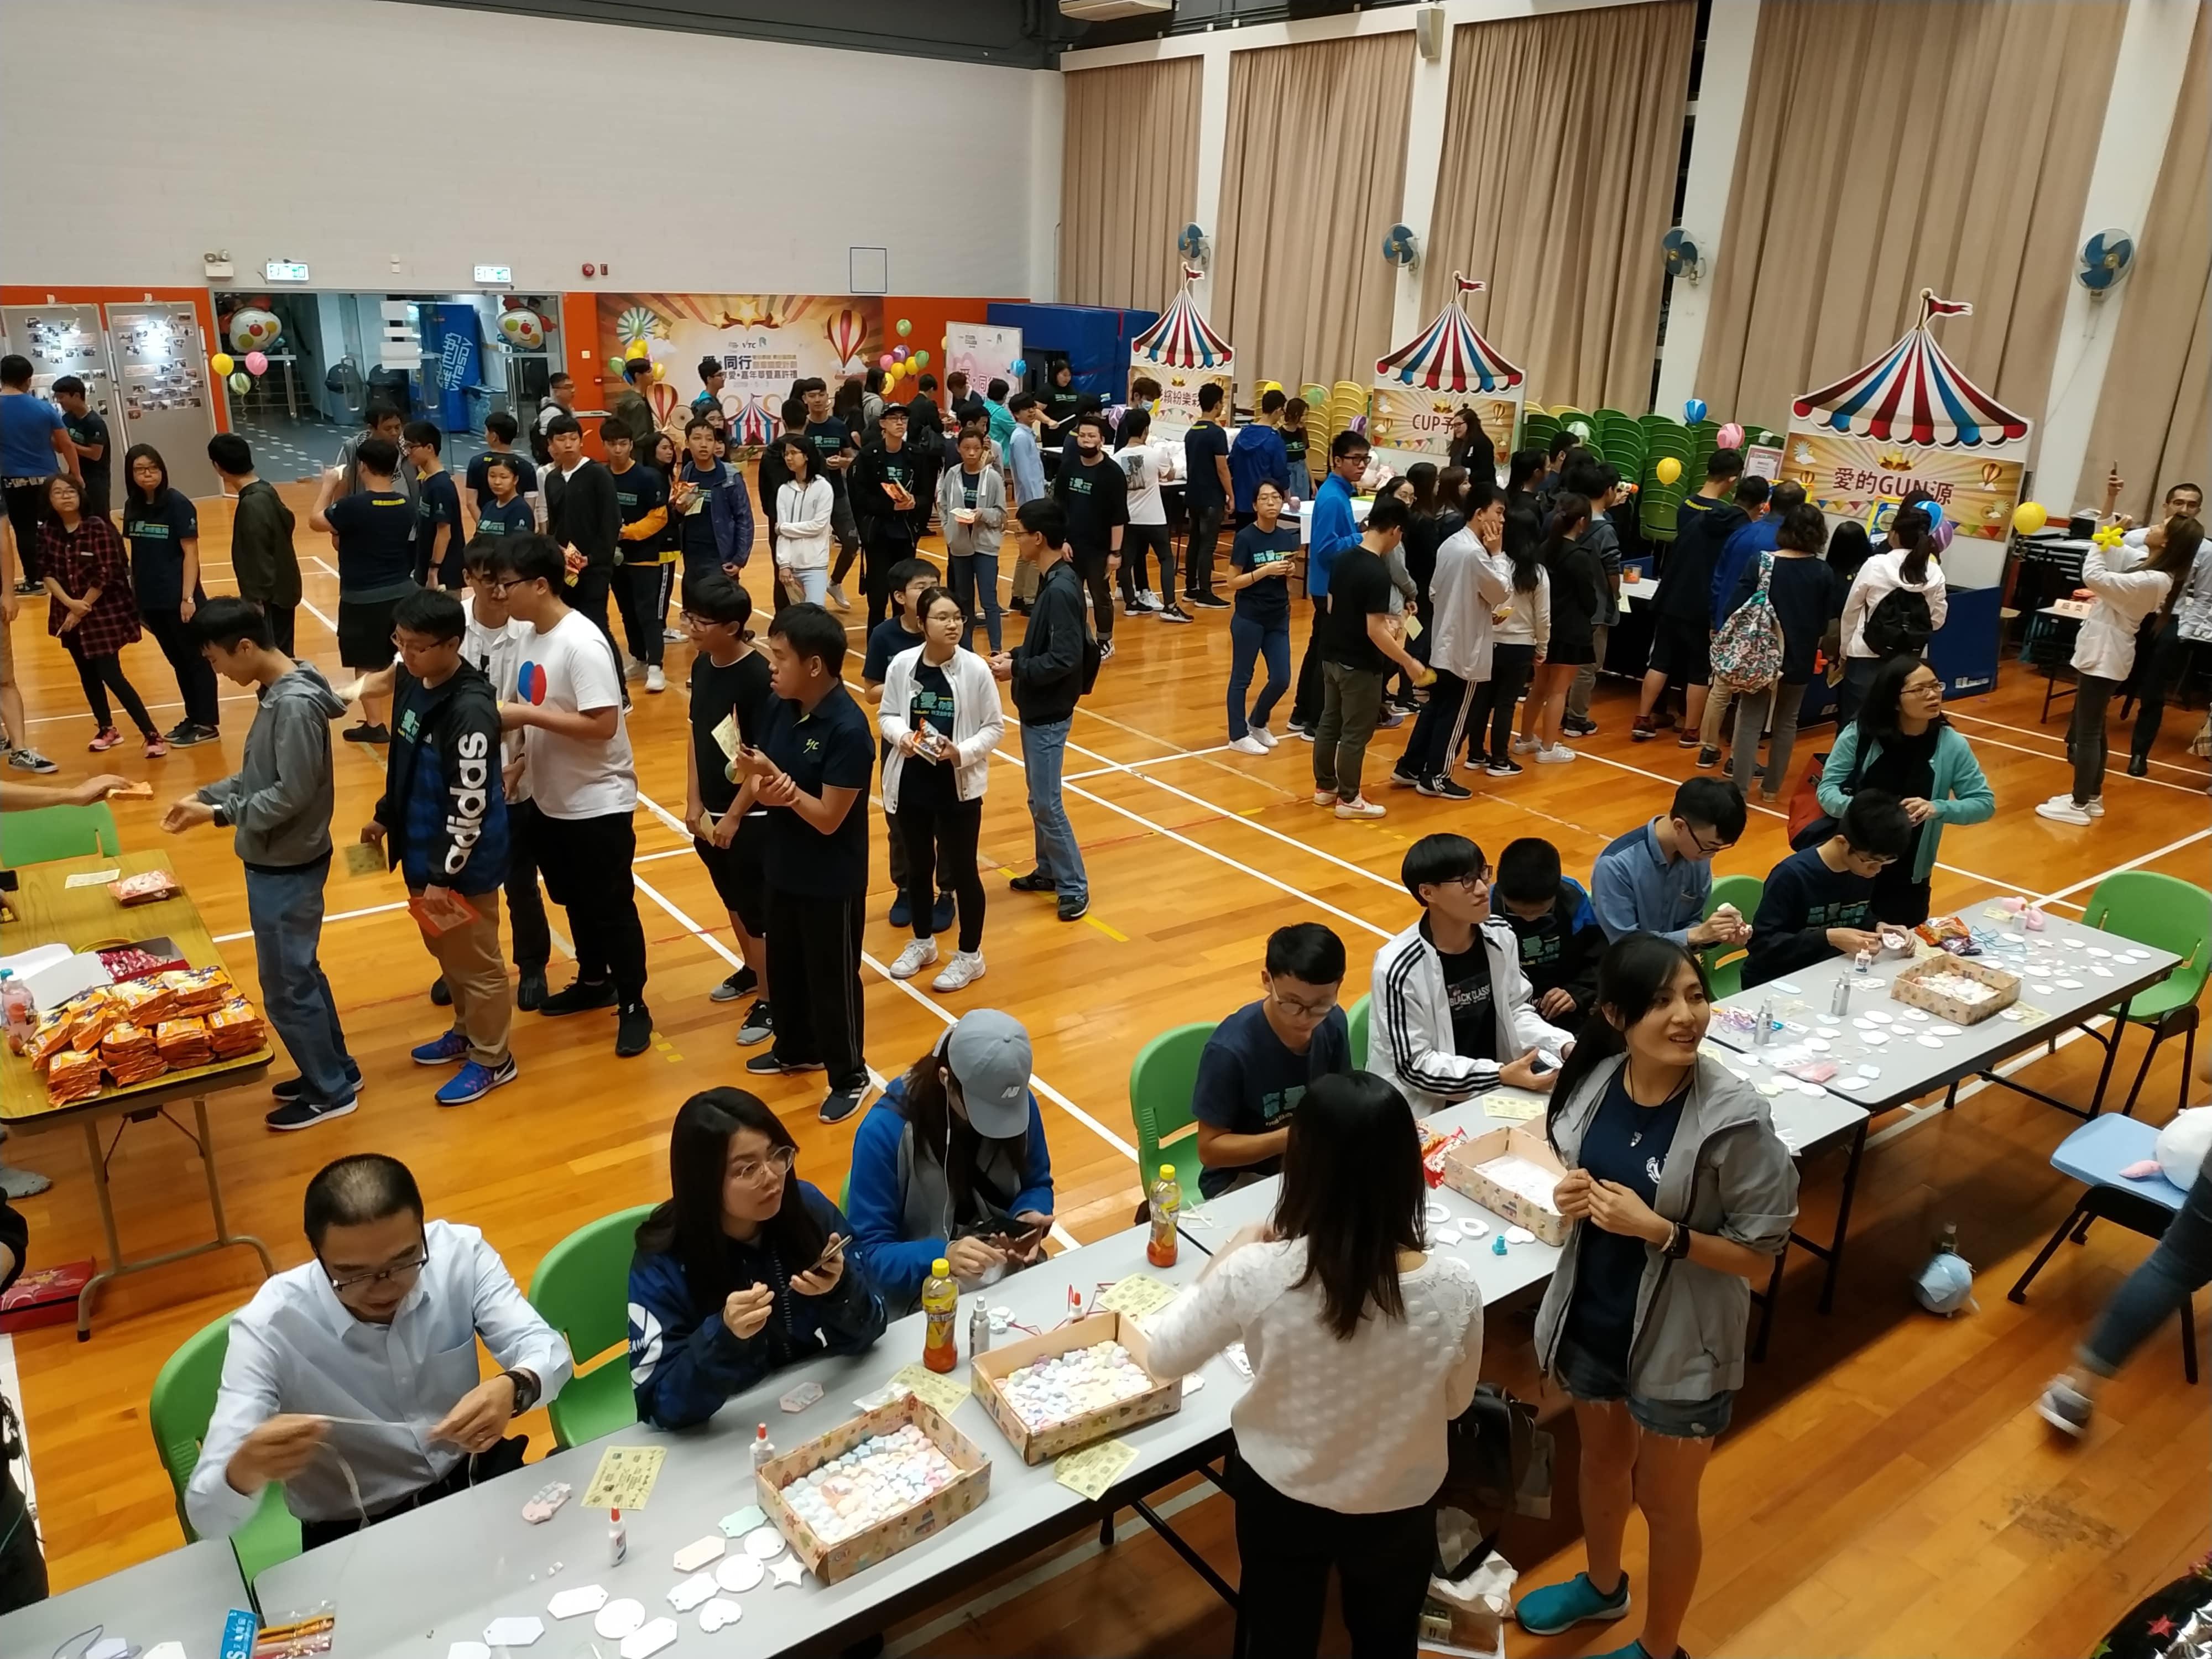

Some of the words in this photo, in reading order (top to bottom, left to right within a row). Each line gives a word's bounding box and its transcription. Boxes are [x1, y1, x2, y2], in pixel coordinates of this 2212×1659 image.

[742, 339, 757, 348] VTC
[1833, 467, 1955, 505] 愛的GUN源
[445, 732, 488, 875] adidas
[1449, 992, 1472, 1006] BLACK
